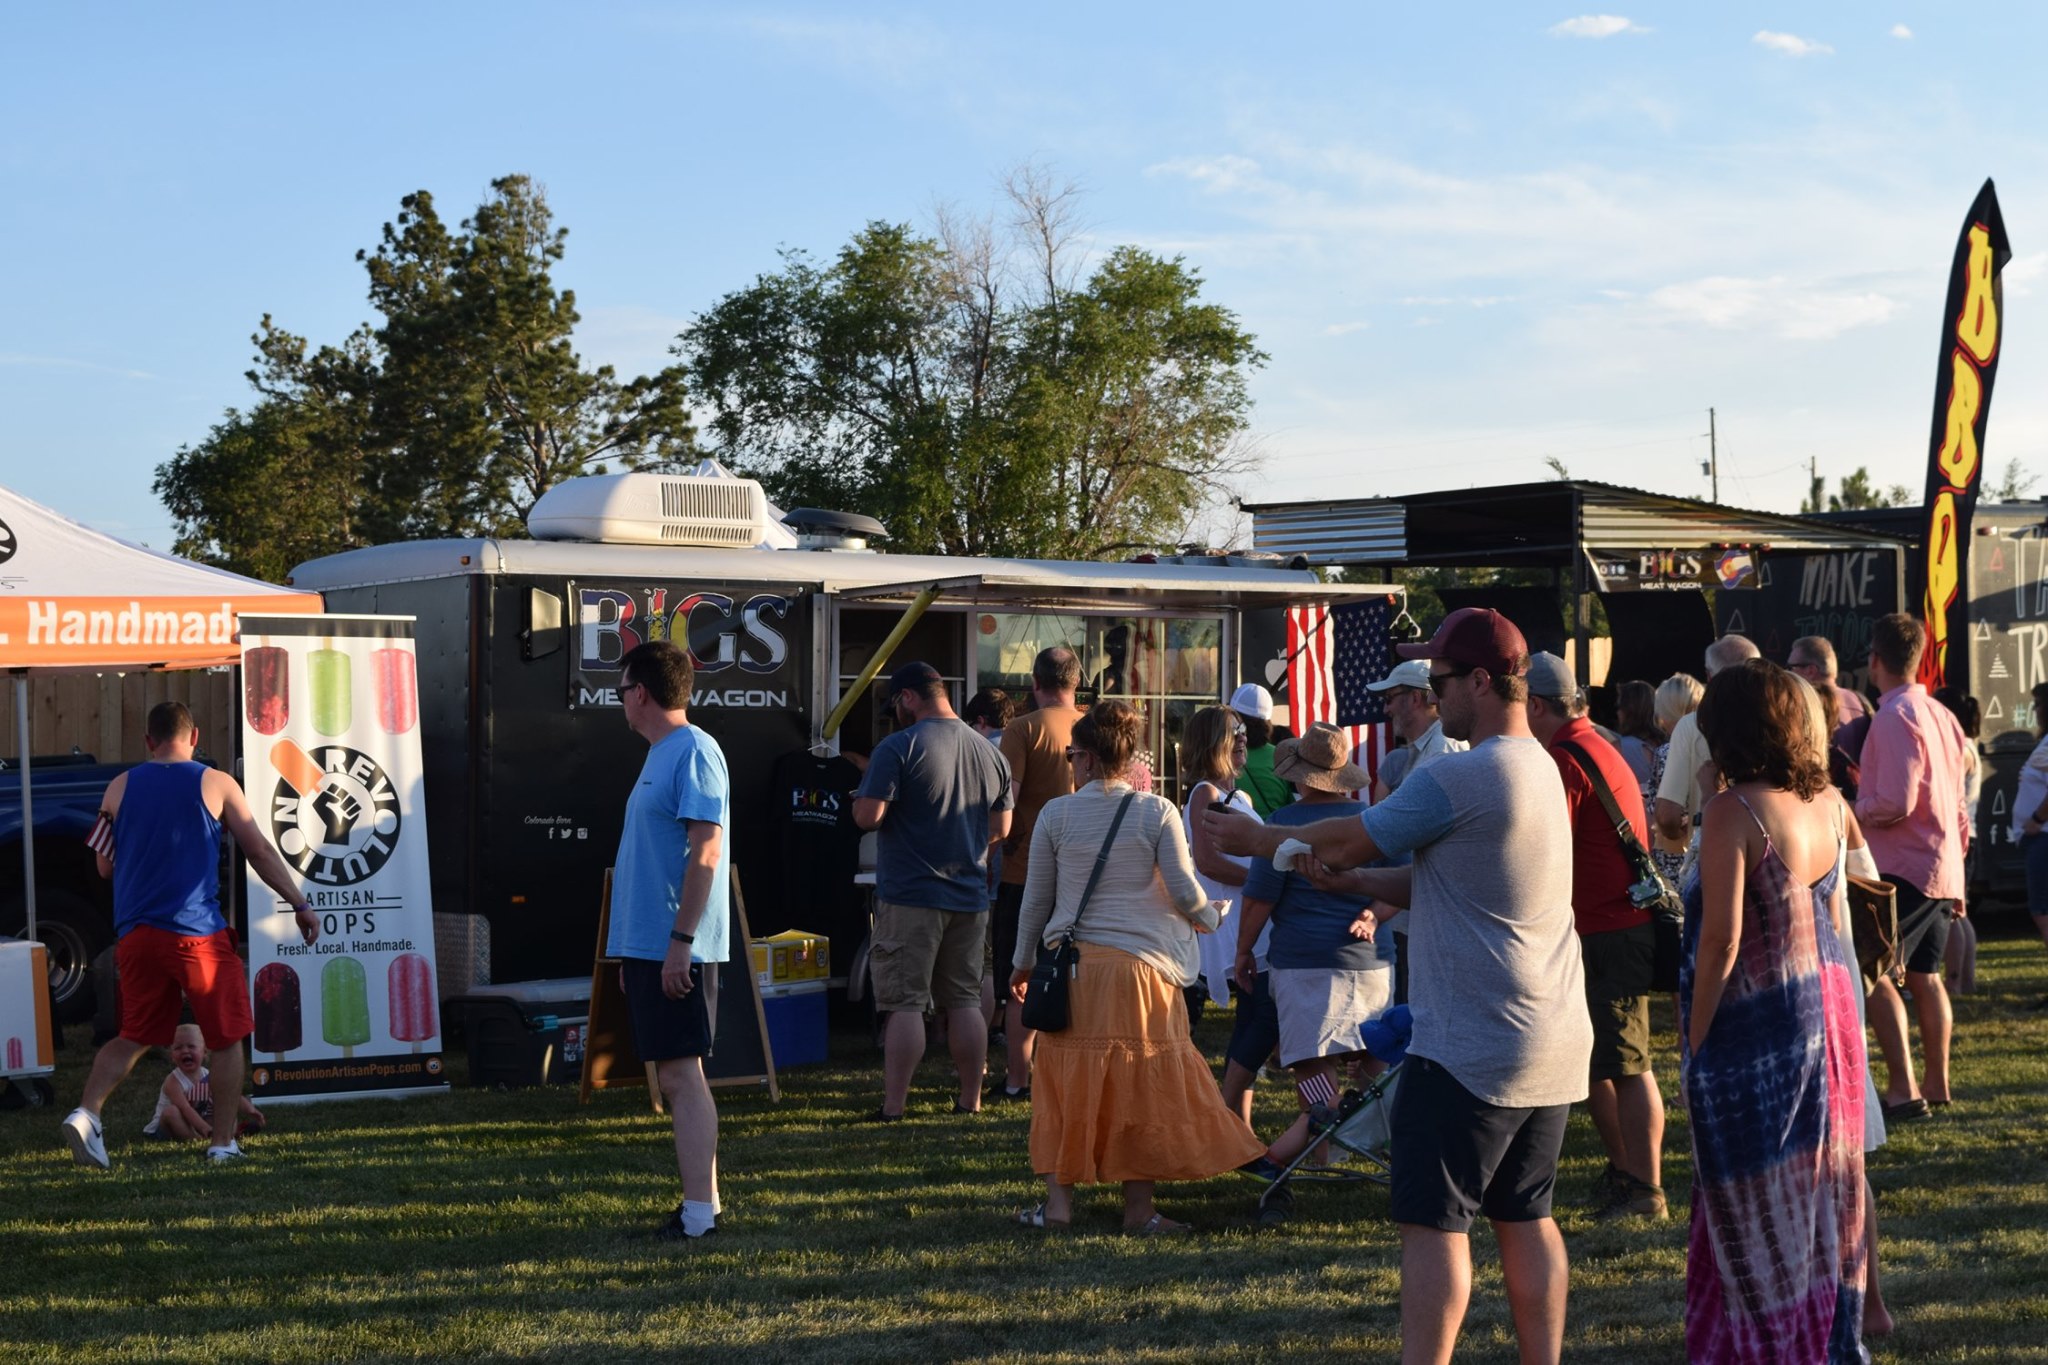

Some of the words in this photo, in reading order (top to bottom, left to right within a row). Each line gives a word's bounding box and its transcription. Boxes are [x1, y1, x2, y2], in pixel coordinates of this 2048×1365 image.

[1667, 582, 1702, 590] WAGON
[1799, 552, 1878, 610] MAKE
[27, 601, 240, 645] Handmad
[580, 688, 623, 706] ME
[274, 749, 397, 882] REVOLUTION
[524, 815, 555, 824] Colorado
[556, 815, 572, 824] Born
[305, 890, 374, 906] ARTISAN
[323, 912, 375, 935] OPS
[277, 943, 311, 956] Fresh.
[315, 941, 348, 954] Local.
[352, 939, 416, 953] Handmade.
[274, 1063, 422, 1081] RevolutionArtisanPops.com
